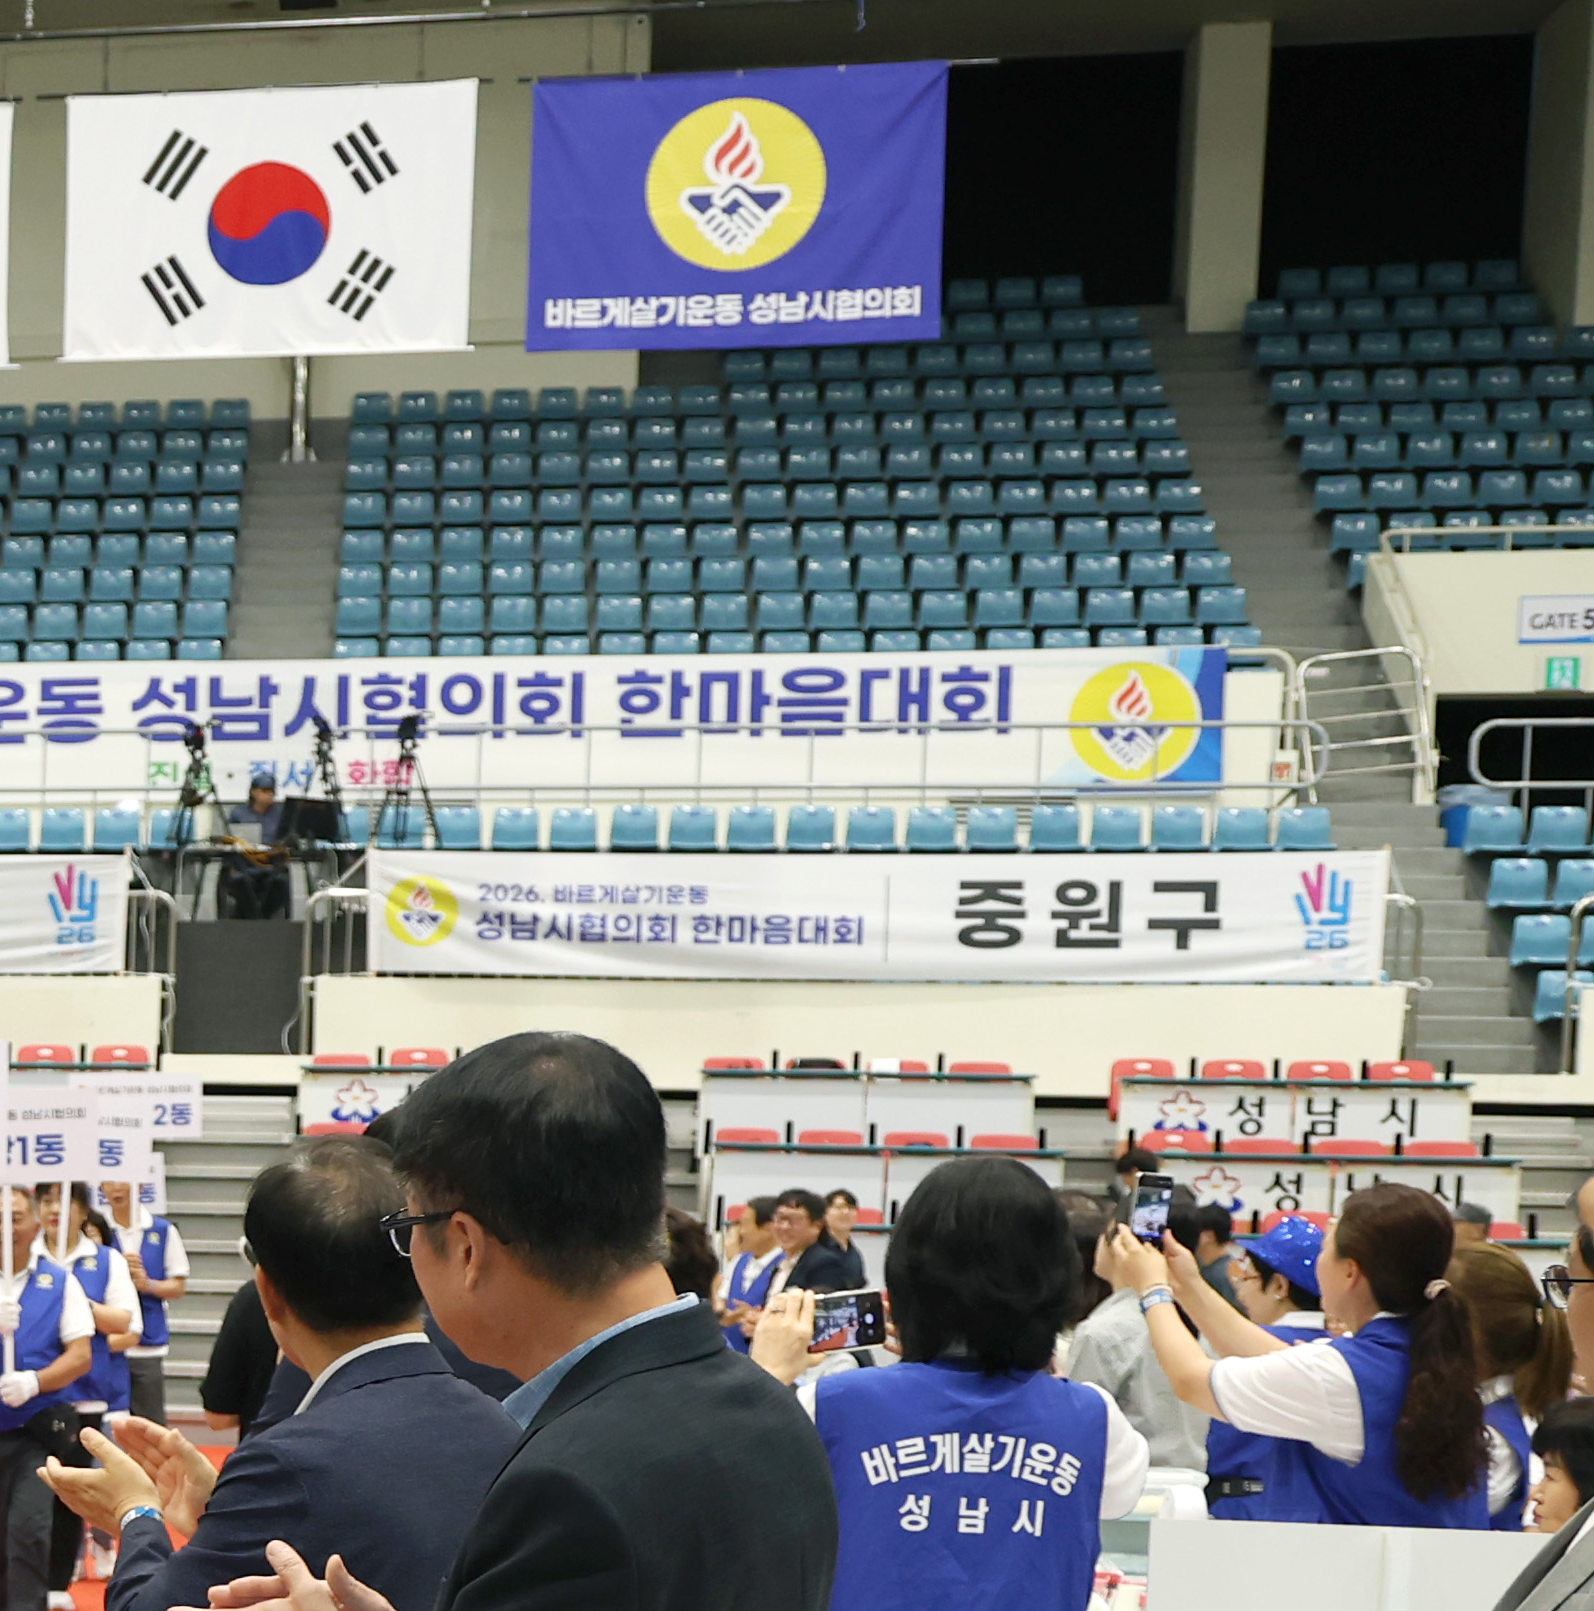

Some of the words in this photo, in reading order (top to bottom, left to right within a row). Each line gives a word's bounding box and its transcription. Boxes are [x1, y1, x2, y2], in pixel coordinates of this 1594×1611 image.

[544, 293, 744, 329] 바르게살기운동
[747, 284, 922, 325] 성남시협의회
[1529, 612, 1579, 630] GATE
[1582, 608, 1594, 630] 5
[131, 668, 585, 742] 성남시협의회
[616, 664, 1013, 738] 한마음대회
[478, 883, 546, 904] 2026.
[552, 883, 709, 905] 바르게살기운동
[954, 879, 1222, 950] 중원구
[475, 912, 678, 944] 성남시협의회
[692, 914, 865, 946] 한마음대회
[1228, 1093, 1419, 1138] 성남시
[859, 1431, 1083, 1497] 바르게살기운동
[897, 1494, 1046, 1537] 성남시
